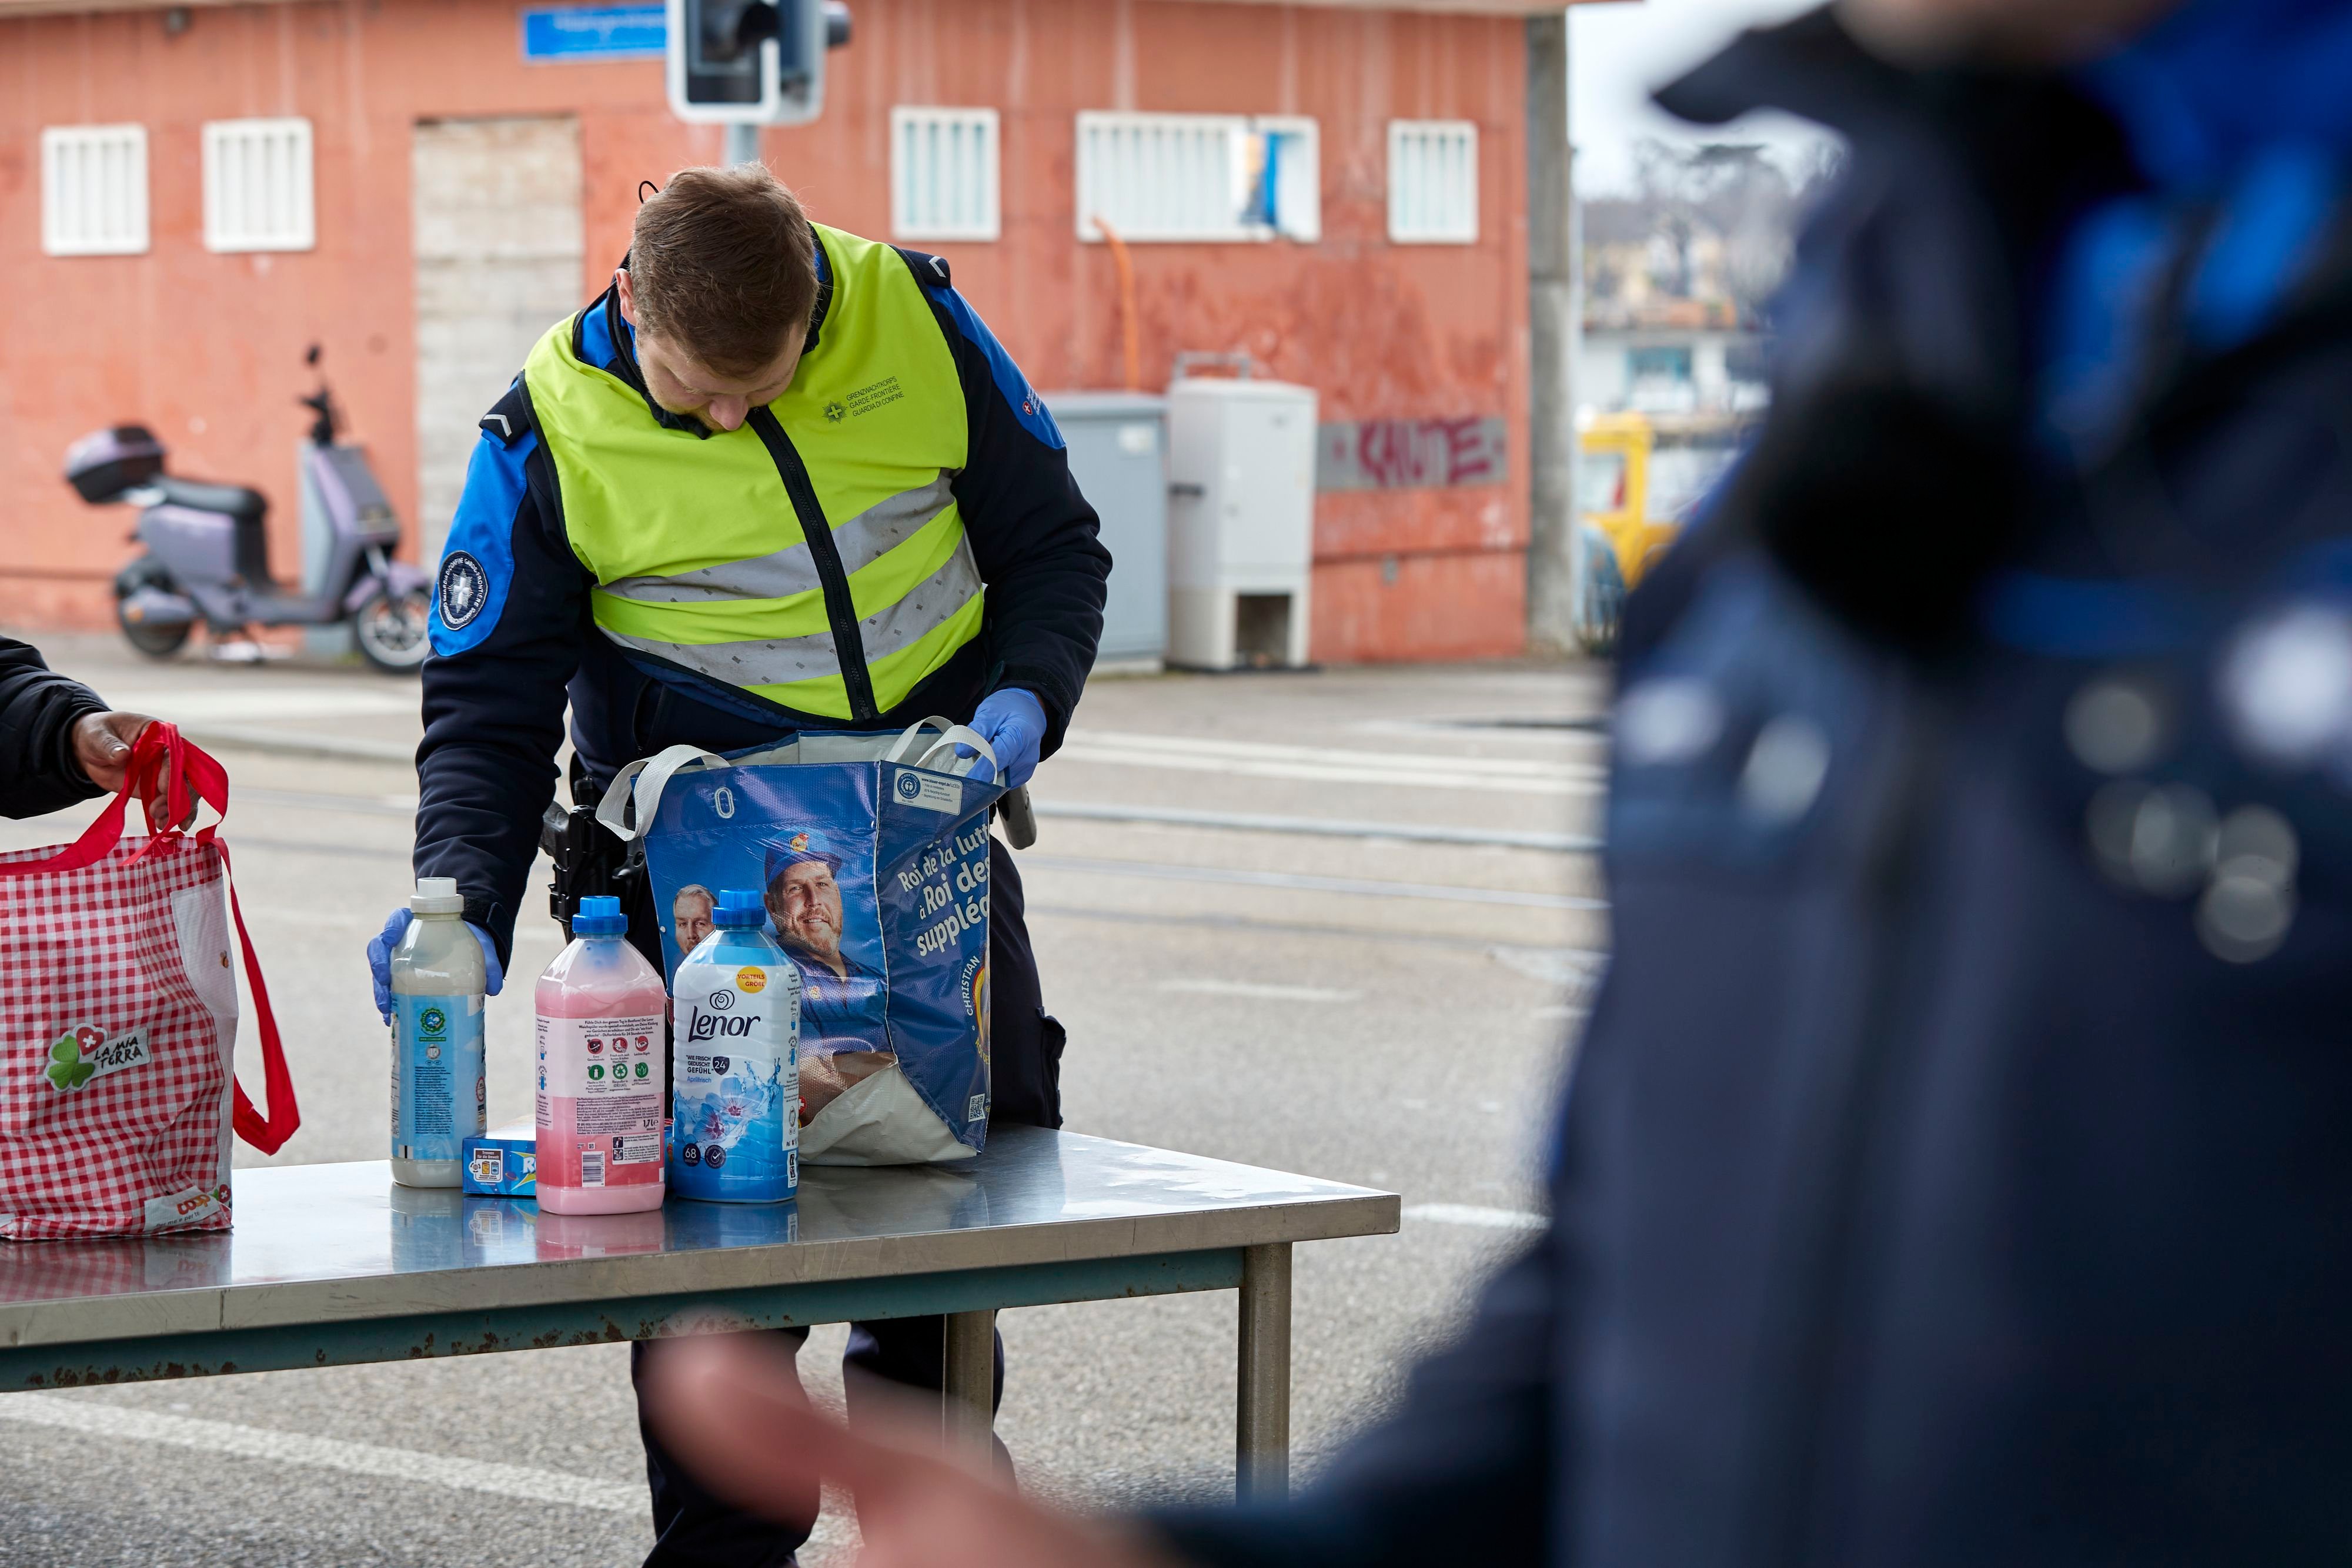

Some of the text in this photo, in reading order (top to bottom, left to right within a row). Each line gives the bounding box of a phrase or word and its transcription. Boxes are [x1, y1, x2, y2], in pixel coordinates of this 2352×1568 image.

[847, 376, 897, 400] GRENZWACHTKORPS
[853, 403, 876, 417] GUARDIA
[882, 391, 904, 405] CONFINE
[898, 862, 924, 892] Roi
[923, 855, 938, 877] de
[937, 847, 957, 868] la
[920, 905, 926, 920] à
[923, 873, 953, 914] Roi
[963, 955, 980, 1016] CHRISTIAN
[688, 1005, 761, 1042] Lenor
[94, 1047, 109, 1061] LA
[101, 1046, 142, 1069] TERRA
[685, 1148, 696, 1158] 68
[177, 1194, 211, 1215] coop
